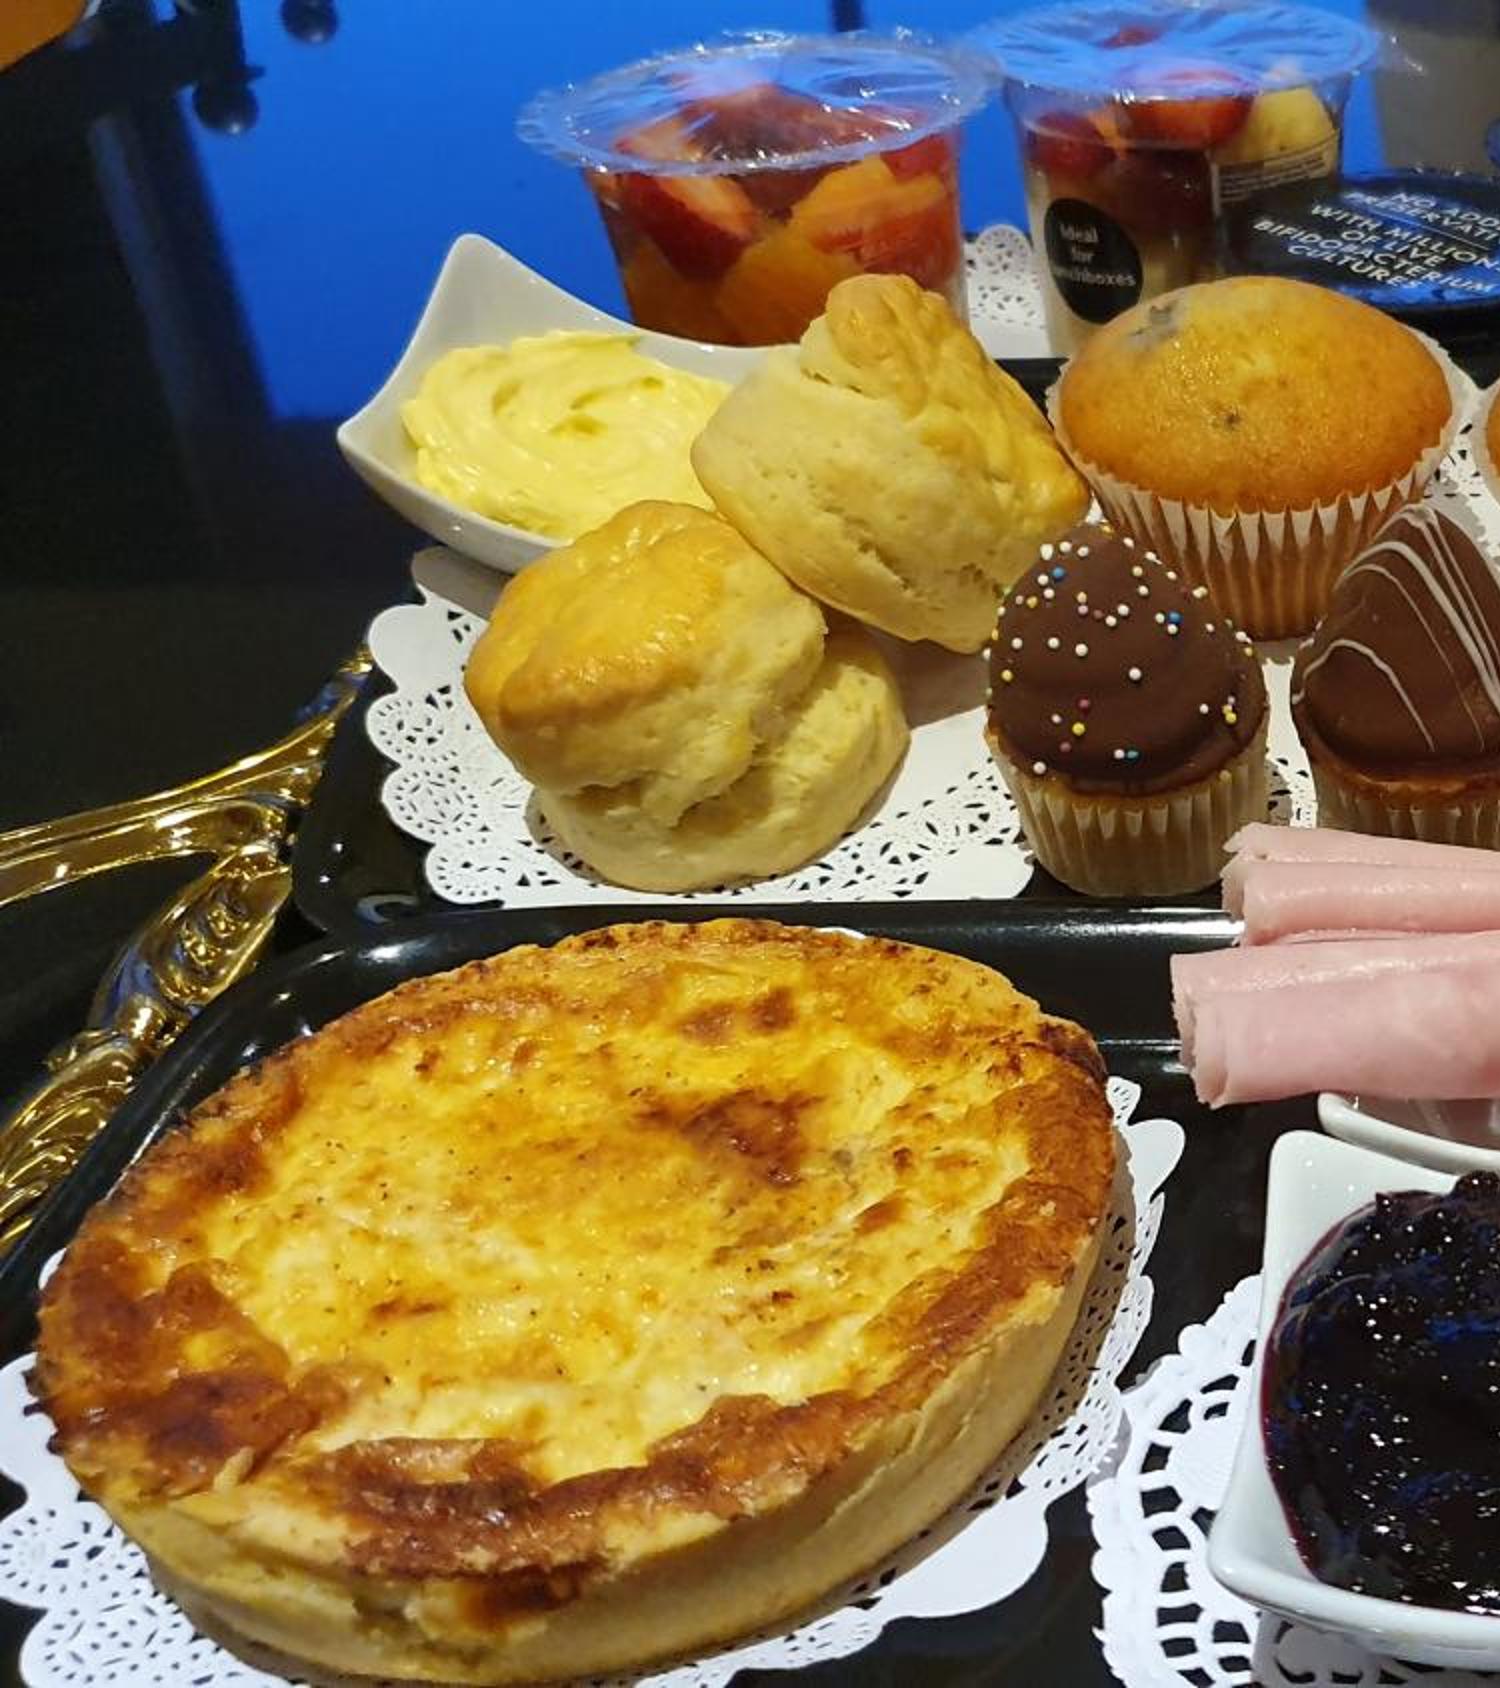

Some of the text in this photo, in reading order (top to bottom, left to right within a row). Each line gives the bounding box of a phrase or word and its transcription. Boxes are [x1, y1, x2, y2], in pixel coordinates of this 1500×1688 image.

[1310, 204, 1381, 231] WITH
[1388, 191, 1437, 210] NO
[1253, 220, 1496, 294] BIFIDOBACTERIUM
[1287, 244, 1426, 290] CULTURES
[1341, 228, 1446, 267] OF LIVE
